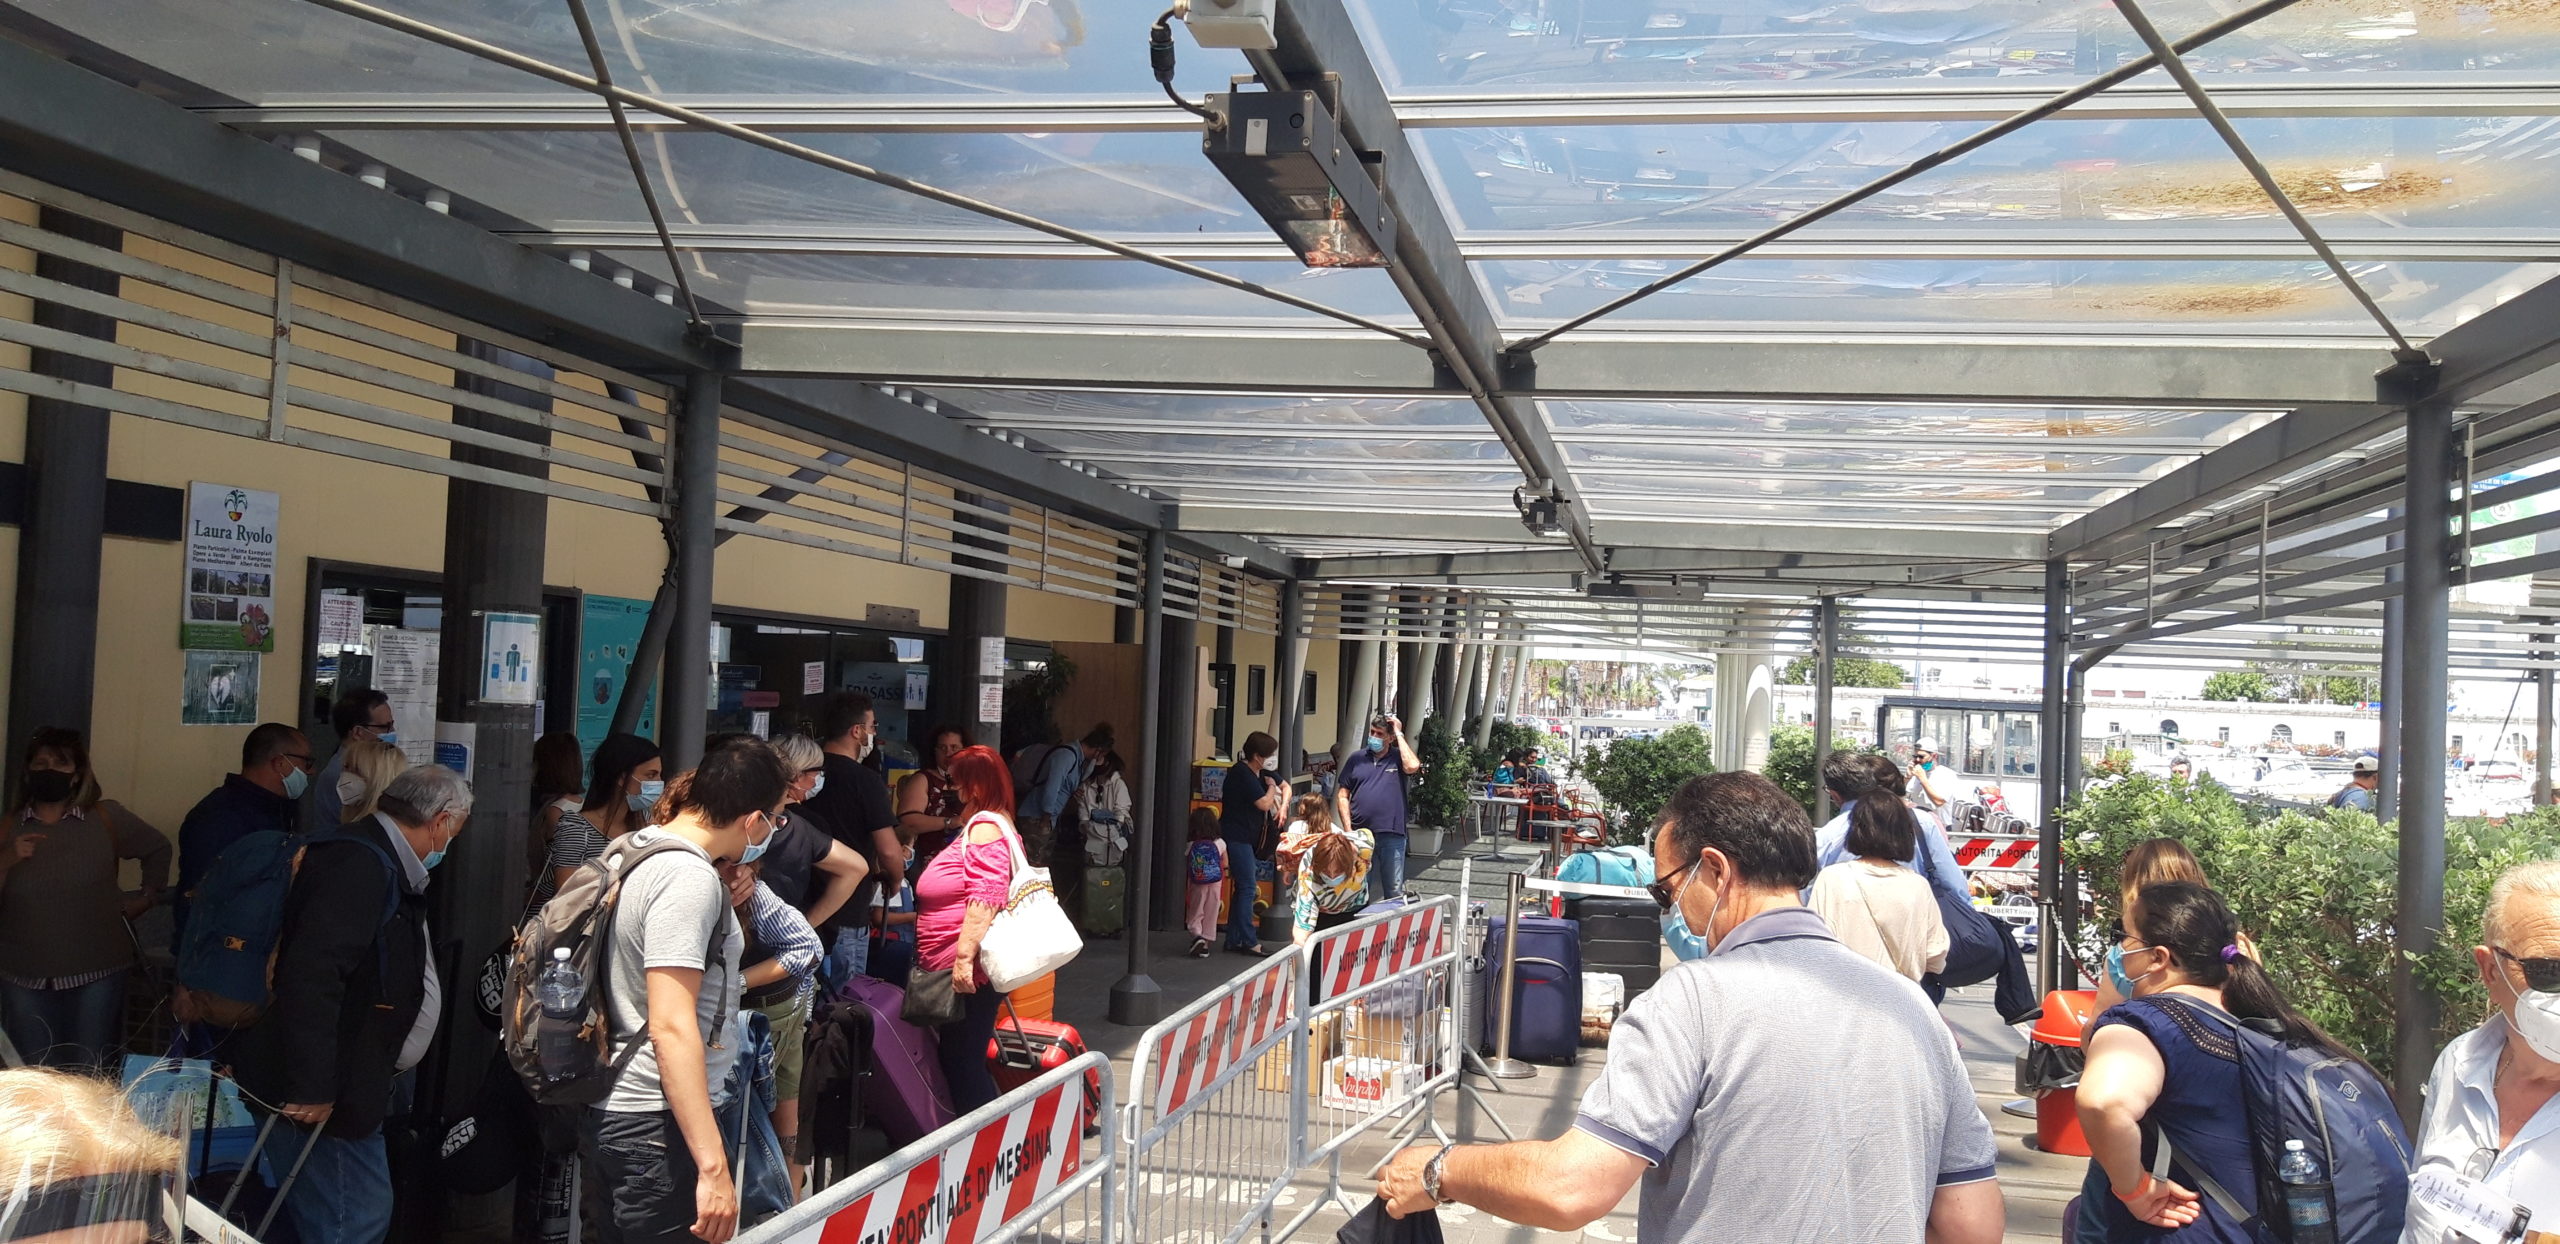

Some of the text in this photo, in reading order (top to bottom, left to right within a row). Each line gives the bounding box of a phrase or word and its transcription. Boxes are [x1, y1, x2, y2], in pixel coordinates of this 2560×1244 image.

[194, 519, 273, 546] Laura Ryolo
[1990, 907, 2018, 915] LIBERTY
[977, 1162, 990, 1203] DI
[995, 1125, 1052, 1191] MESSINA
